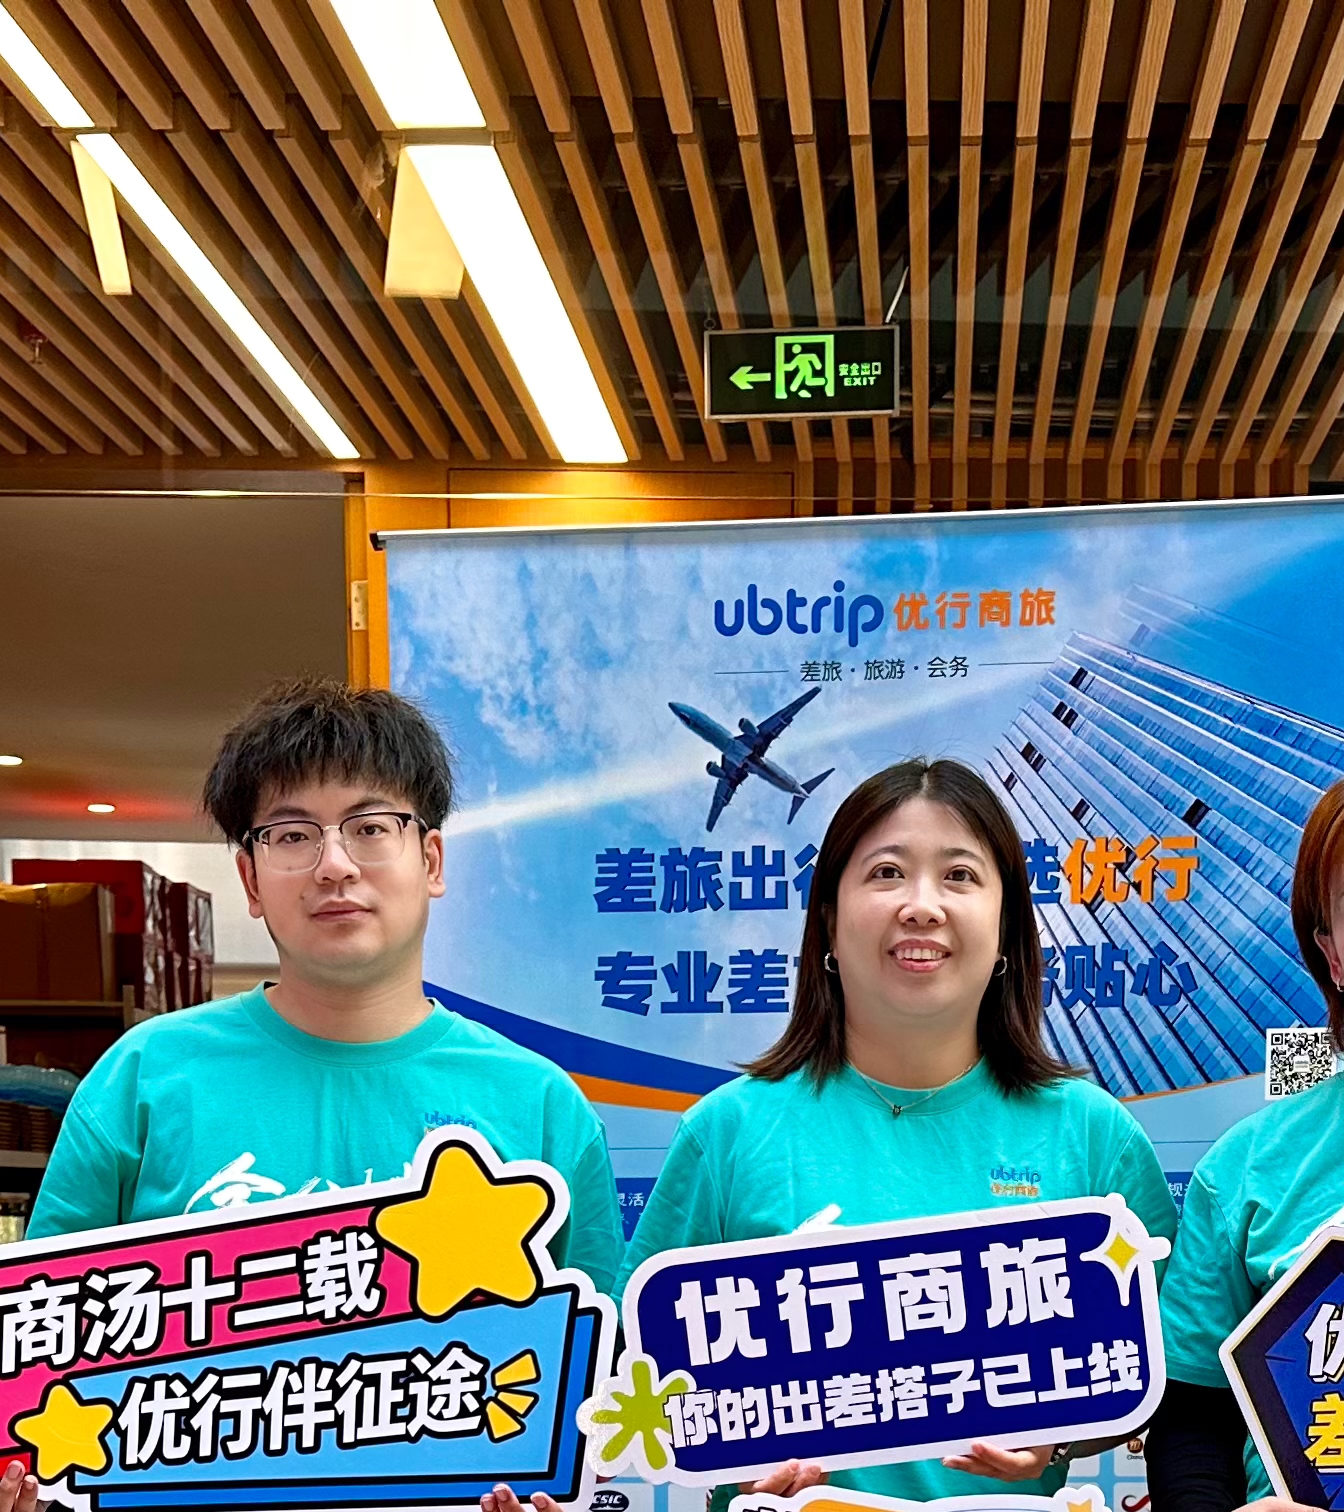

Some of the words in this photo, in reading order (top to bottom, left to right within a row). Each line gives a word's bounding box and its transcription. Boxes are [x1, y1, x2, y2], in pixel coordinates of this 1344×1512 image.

[843, 376, 876, 386] EXIT
[714, 580, 884, 648] ubtrip
[893, 587, 1057, 631] 优行商旅
[594, 948, 799, 1016] 专业差
[991, 1165, 1041, 1185] ubtrip
[675, 1235, 1074, 1367] 优行商旅
[119, 1350, 487, 1464] 优行伴征途
[664, 1339, 1144, 1448] 你的出差搭子已上线
